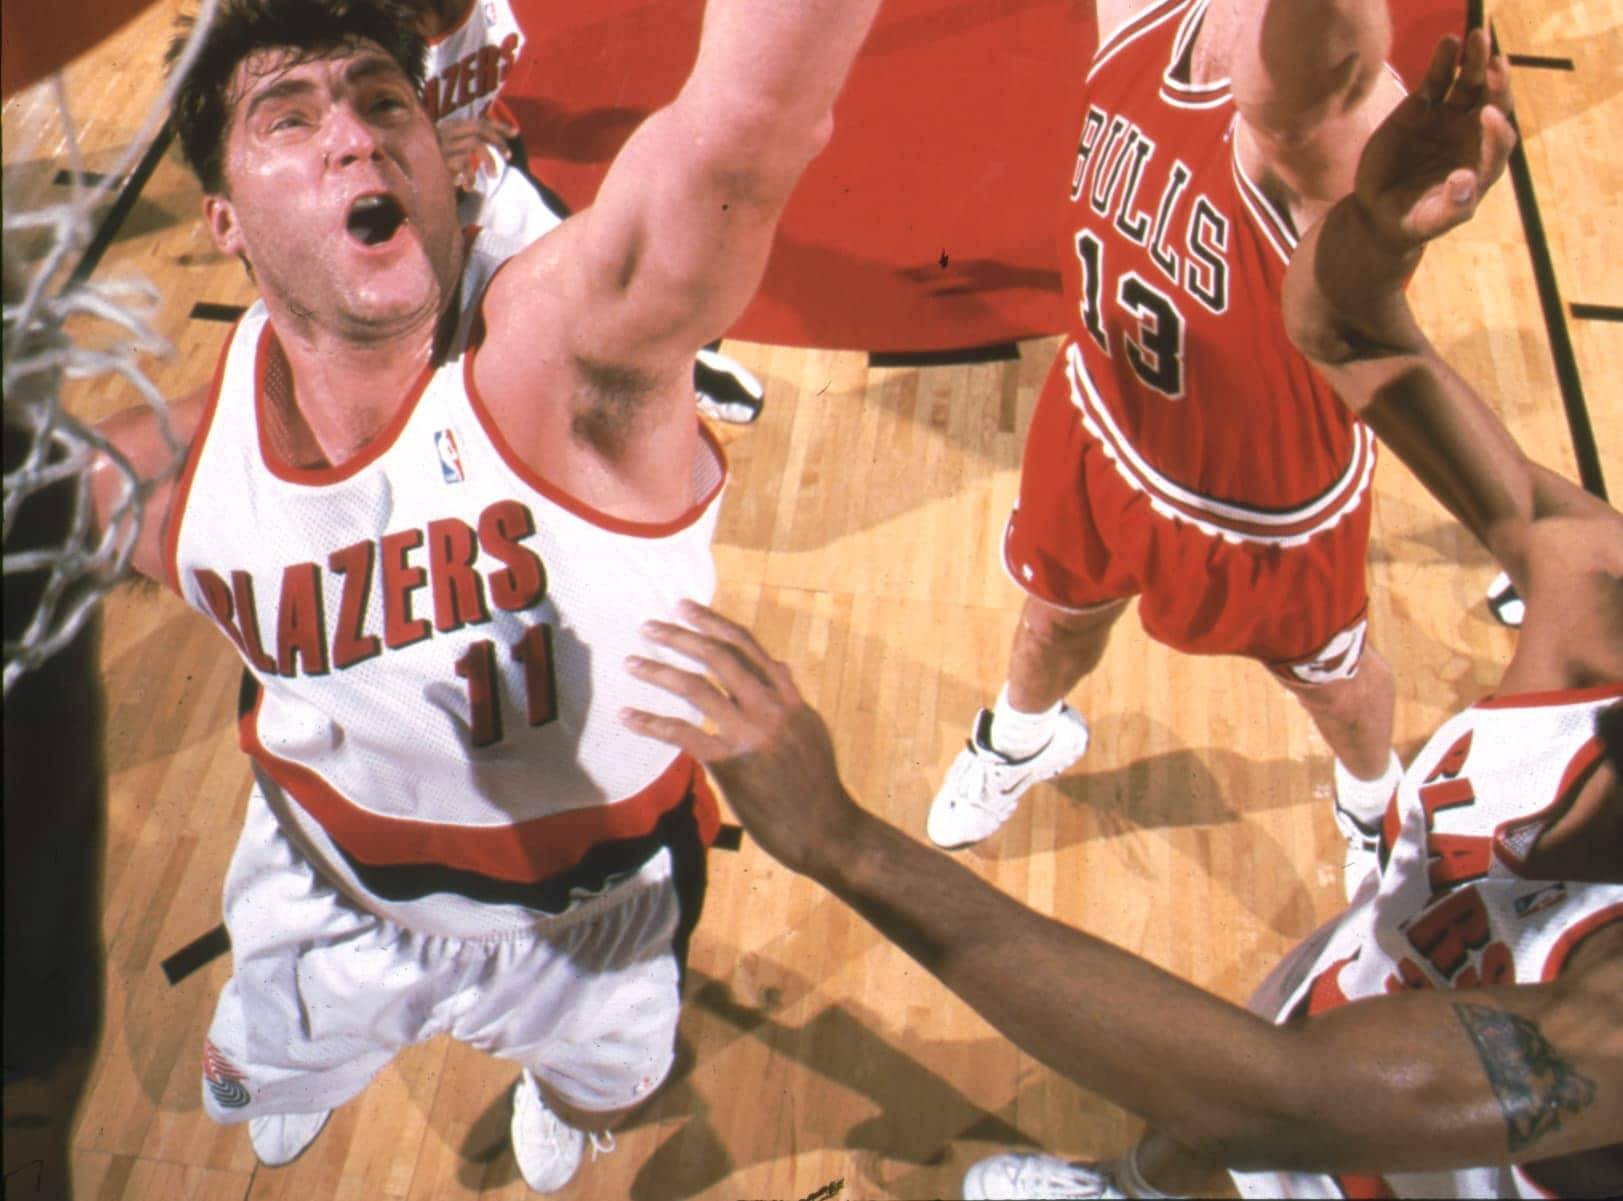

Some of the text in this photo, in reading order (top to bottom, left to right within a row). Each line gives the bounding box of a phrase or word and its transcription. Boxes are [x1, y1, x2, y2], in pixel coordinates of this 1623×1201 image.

[1069, 104, 1229, 315] BULLS
[1074, 228, 1186, 400] 13
[193, 499, 548, 678] BLAZERS
[454, 623, 559, 748] 11
